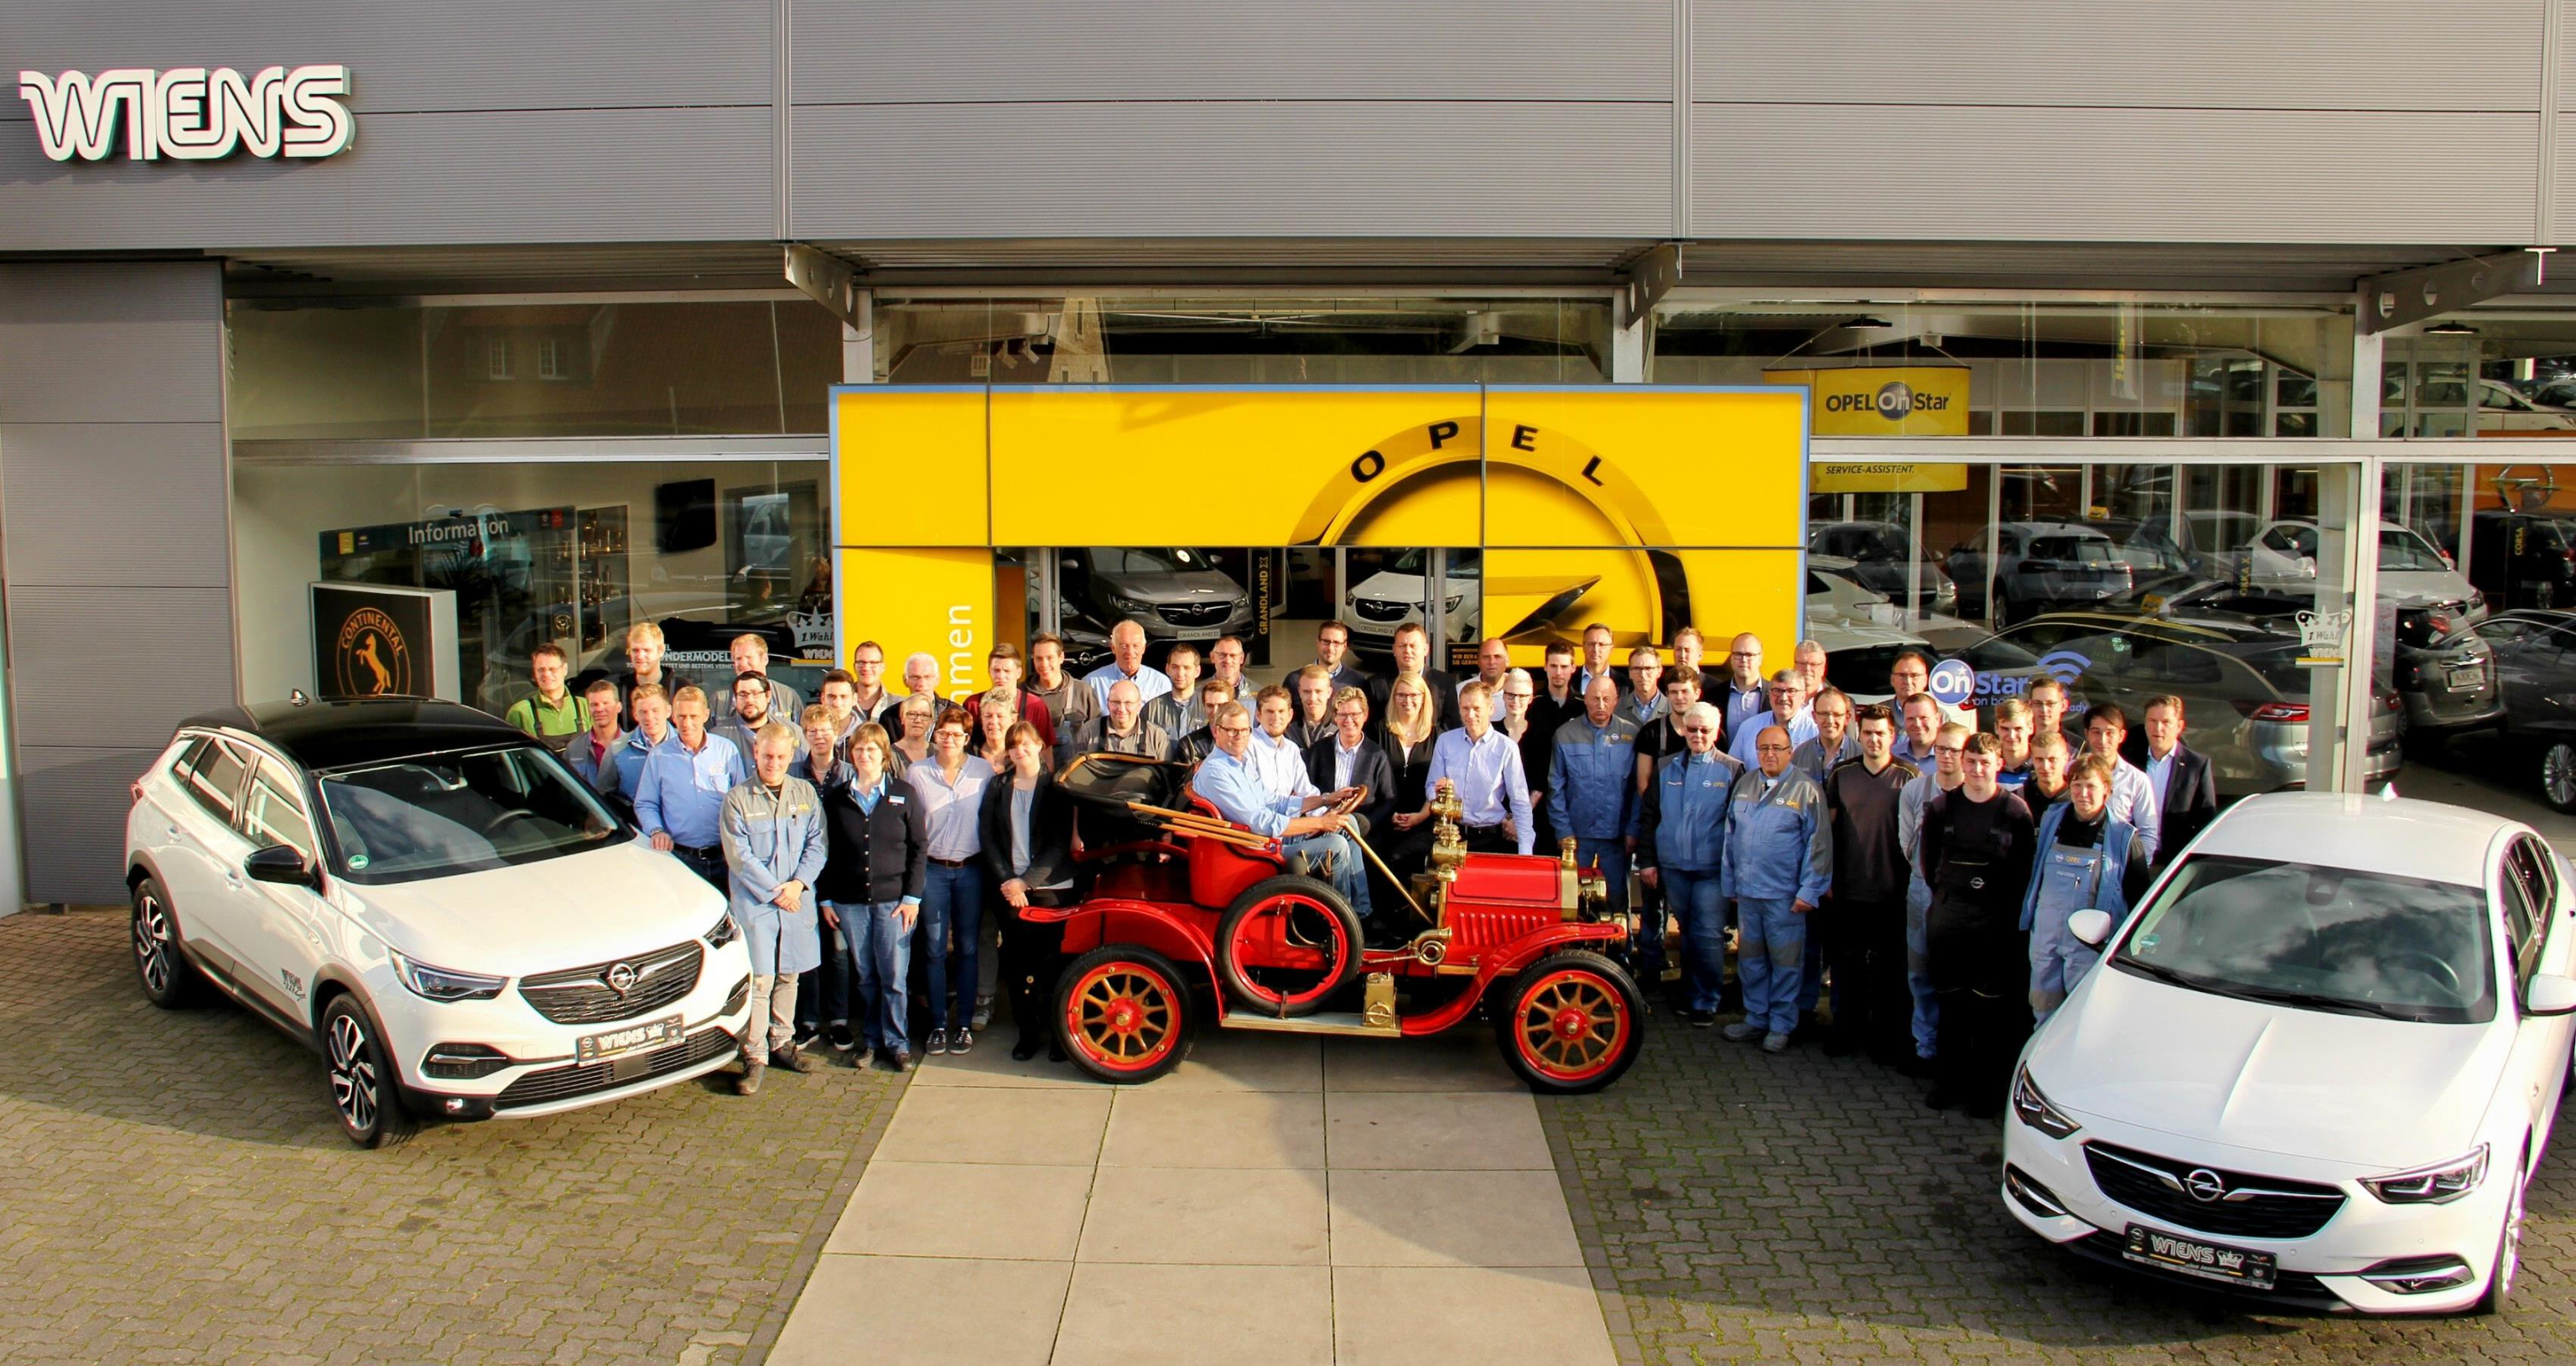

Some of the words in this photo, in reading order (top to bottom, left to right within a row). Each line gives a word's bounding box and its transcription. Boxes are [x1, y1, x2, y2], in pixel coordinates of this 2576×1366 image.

[20, 65, 352, 161] WIENS
[1826, 394, 1875, 412] OPEL
[1351, 421, 1605, 486] OPEL
[1826, 465, 1914, 475] SERVICE-ASSISTENT.
[408, 518, 509, 545] Information
[2514, 527, 2524, 556] CORSA
[2240, 567, 2250, 597] OKKA
[1259, 571, 1269, 635] GRANDLAND
[340, 613, 403, 657] CONTINENTAL
[802, 648, 834, 660] WIEN
[1973, 697, 1988, 706] on
[598, 1026, 647, 1051] WIENS
[2150, 1234, 2215, 1265] WIENS
